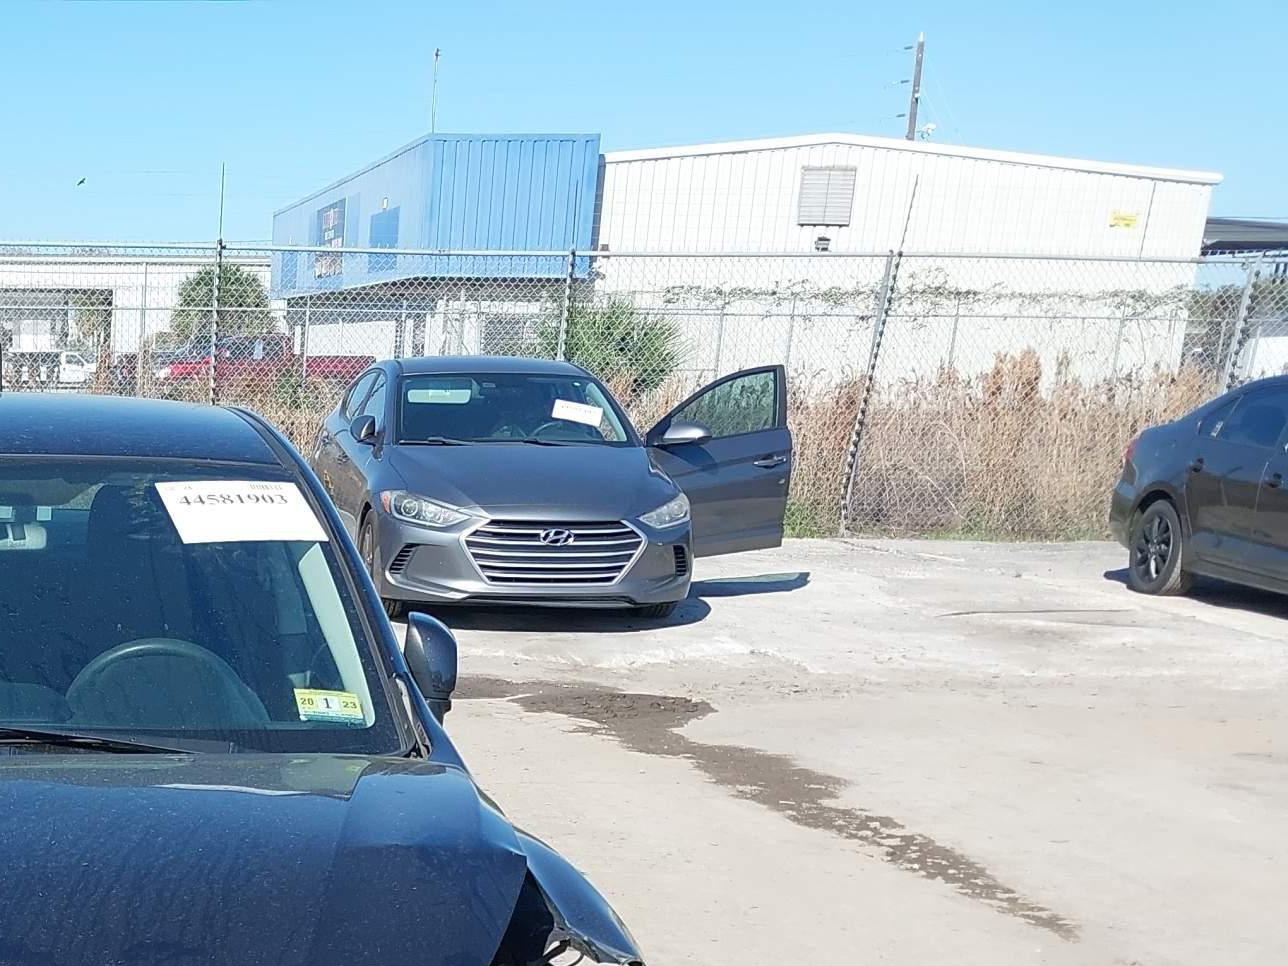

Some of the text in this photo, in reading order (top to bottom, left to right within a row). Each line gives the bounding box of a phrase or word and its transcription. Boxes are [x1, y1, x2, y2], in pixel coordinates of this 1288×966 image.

[179, 493, 289, 506] 44581903
[300, 697, 357, 709] 20 1 23
